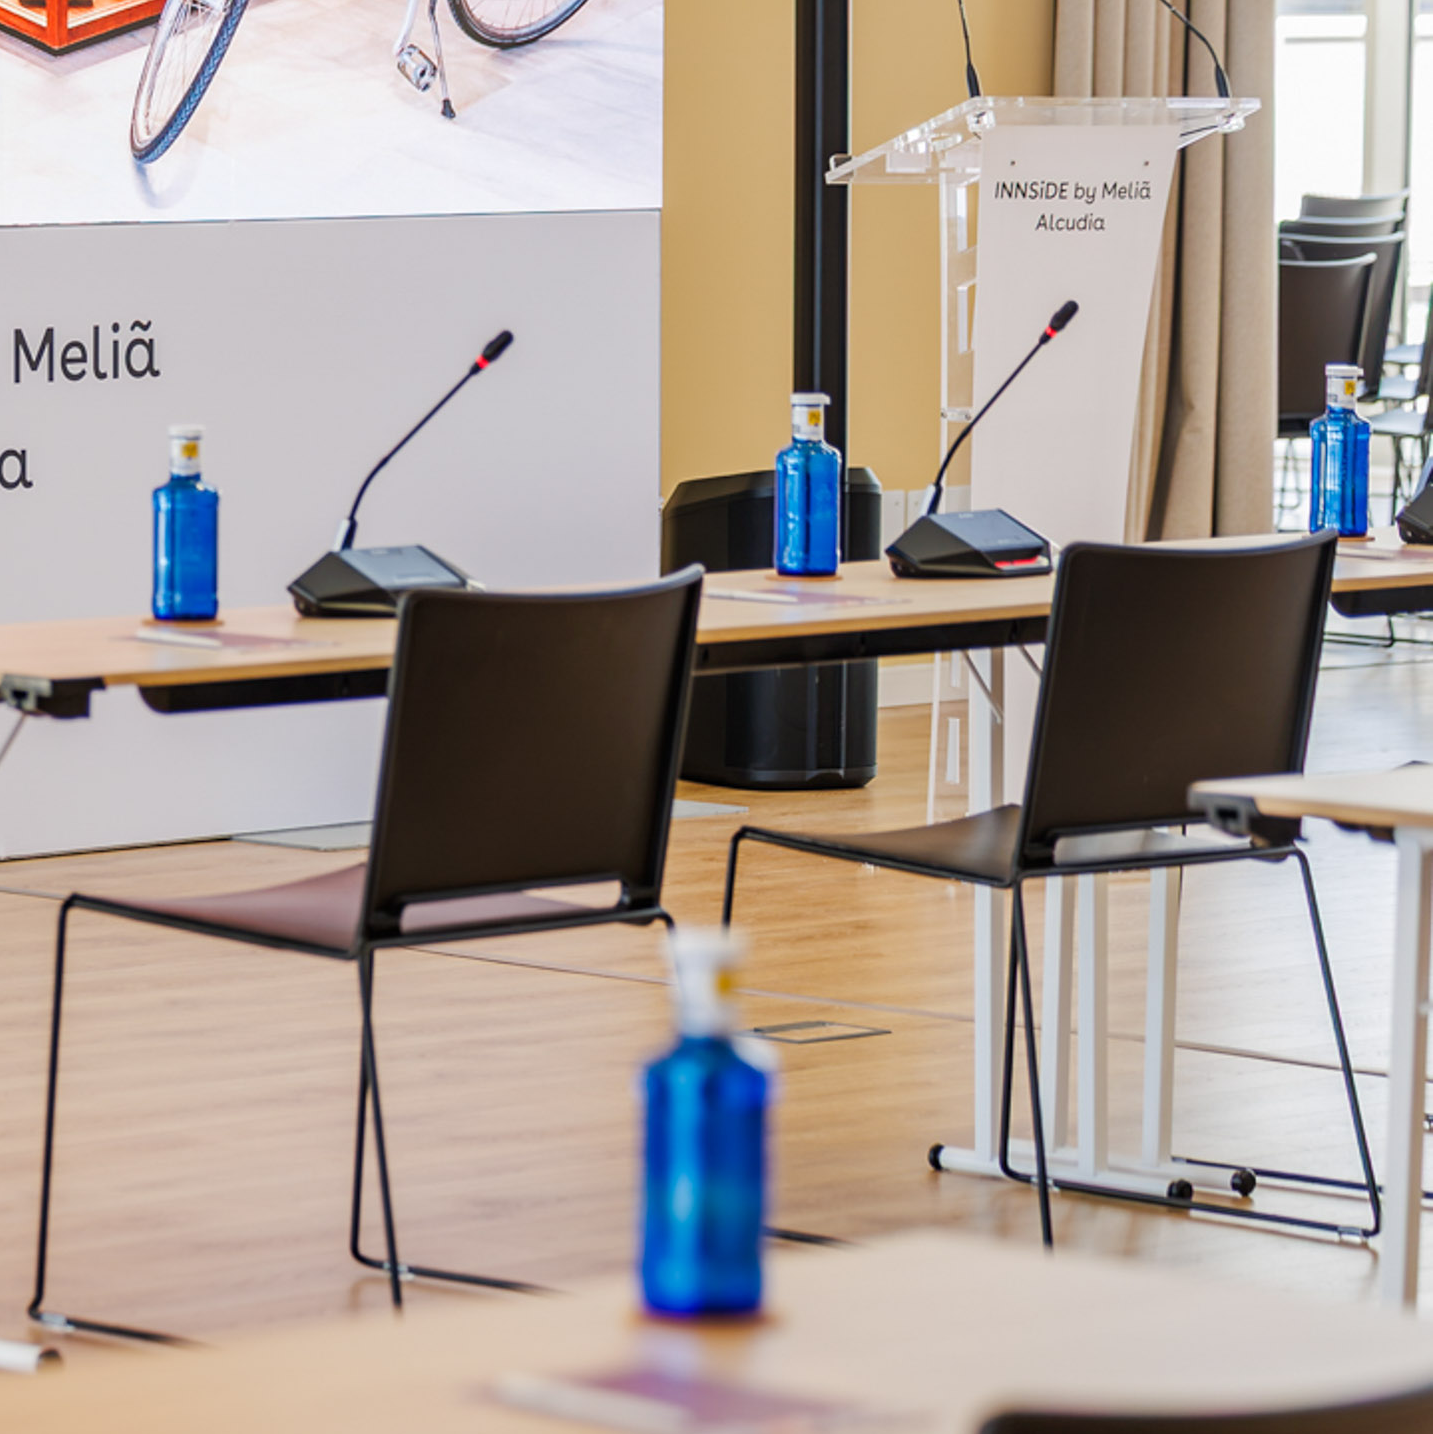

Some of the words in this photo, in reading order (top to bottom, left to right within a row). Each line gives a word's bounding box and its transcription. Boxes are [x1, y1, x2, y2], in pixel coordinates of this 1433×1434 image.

[994, 180, 1069, 200] INNSiDE
[1074, 182, 1097, 204] by
[1035, 213, 1105, 231] Alcudia
